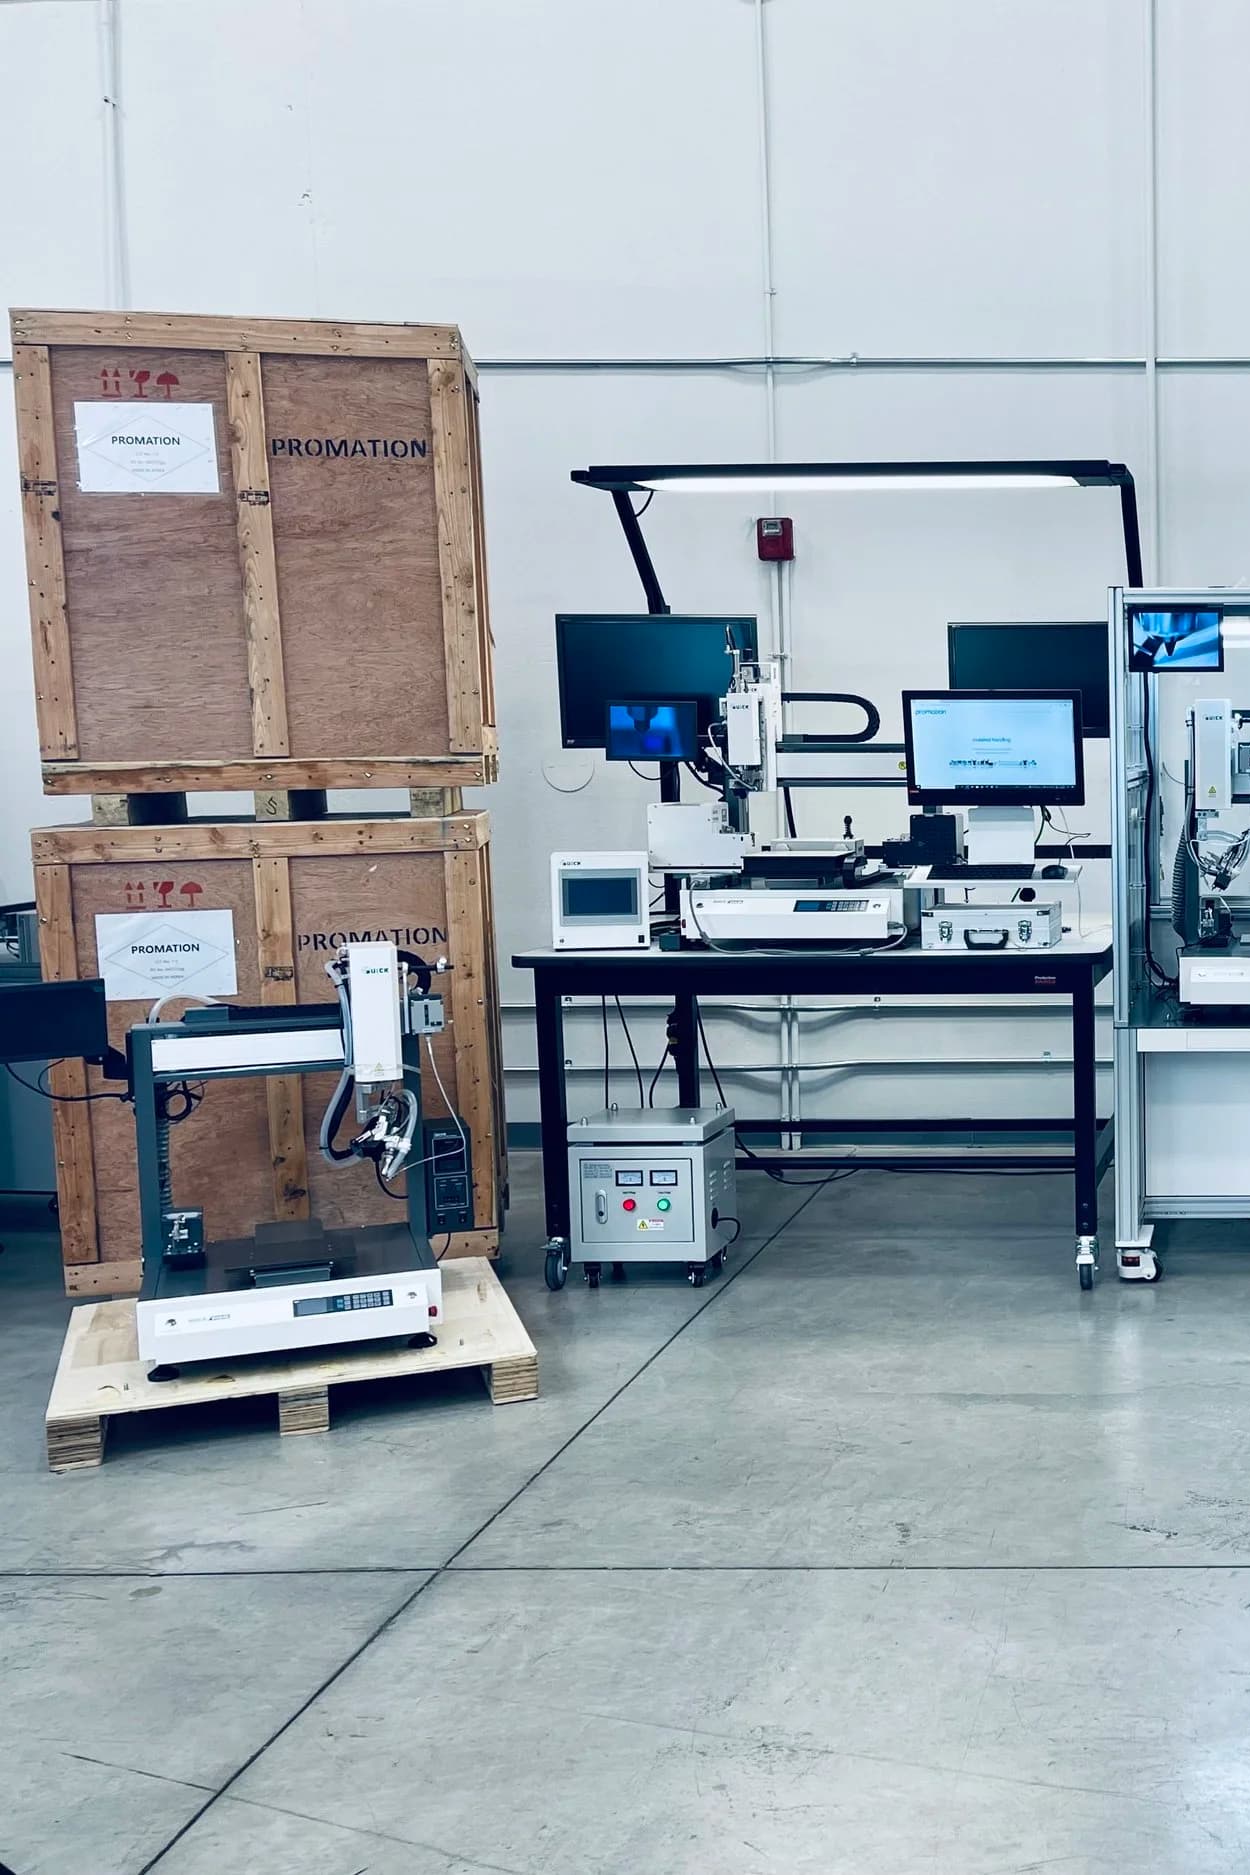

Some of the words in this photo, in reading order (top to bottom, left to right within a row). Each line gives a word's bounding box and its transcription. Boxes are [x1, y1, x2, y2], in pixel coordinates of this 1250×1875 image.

[111, 435, 180, 445] PROMATION
[272, 438, 426, 457] PROMATION
[298, 927, 447, 951] PROMATION
[131, 944, 200, 954] PROMATION
